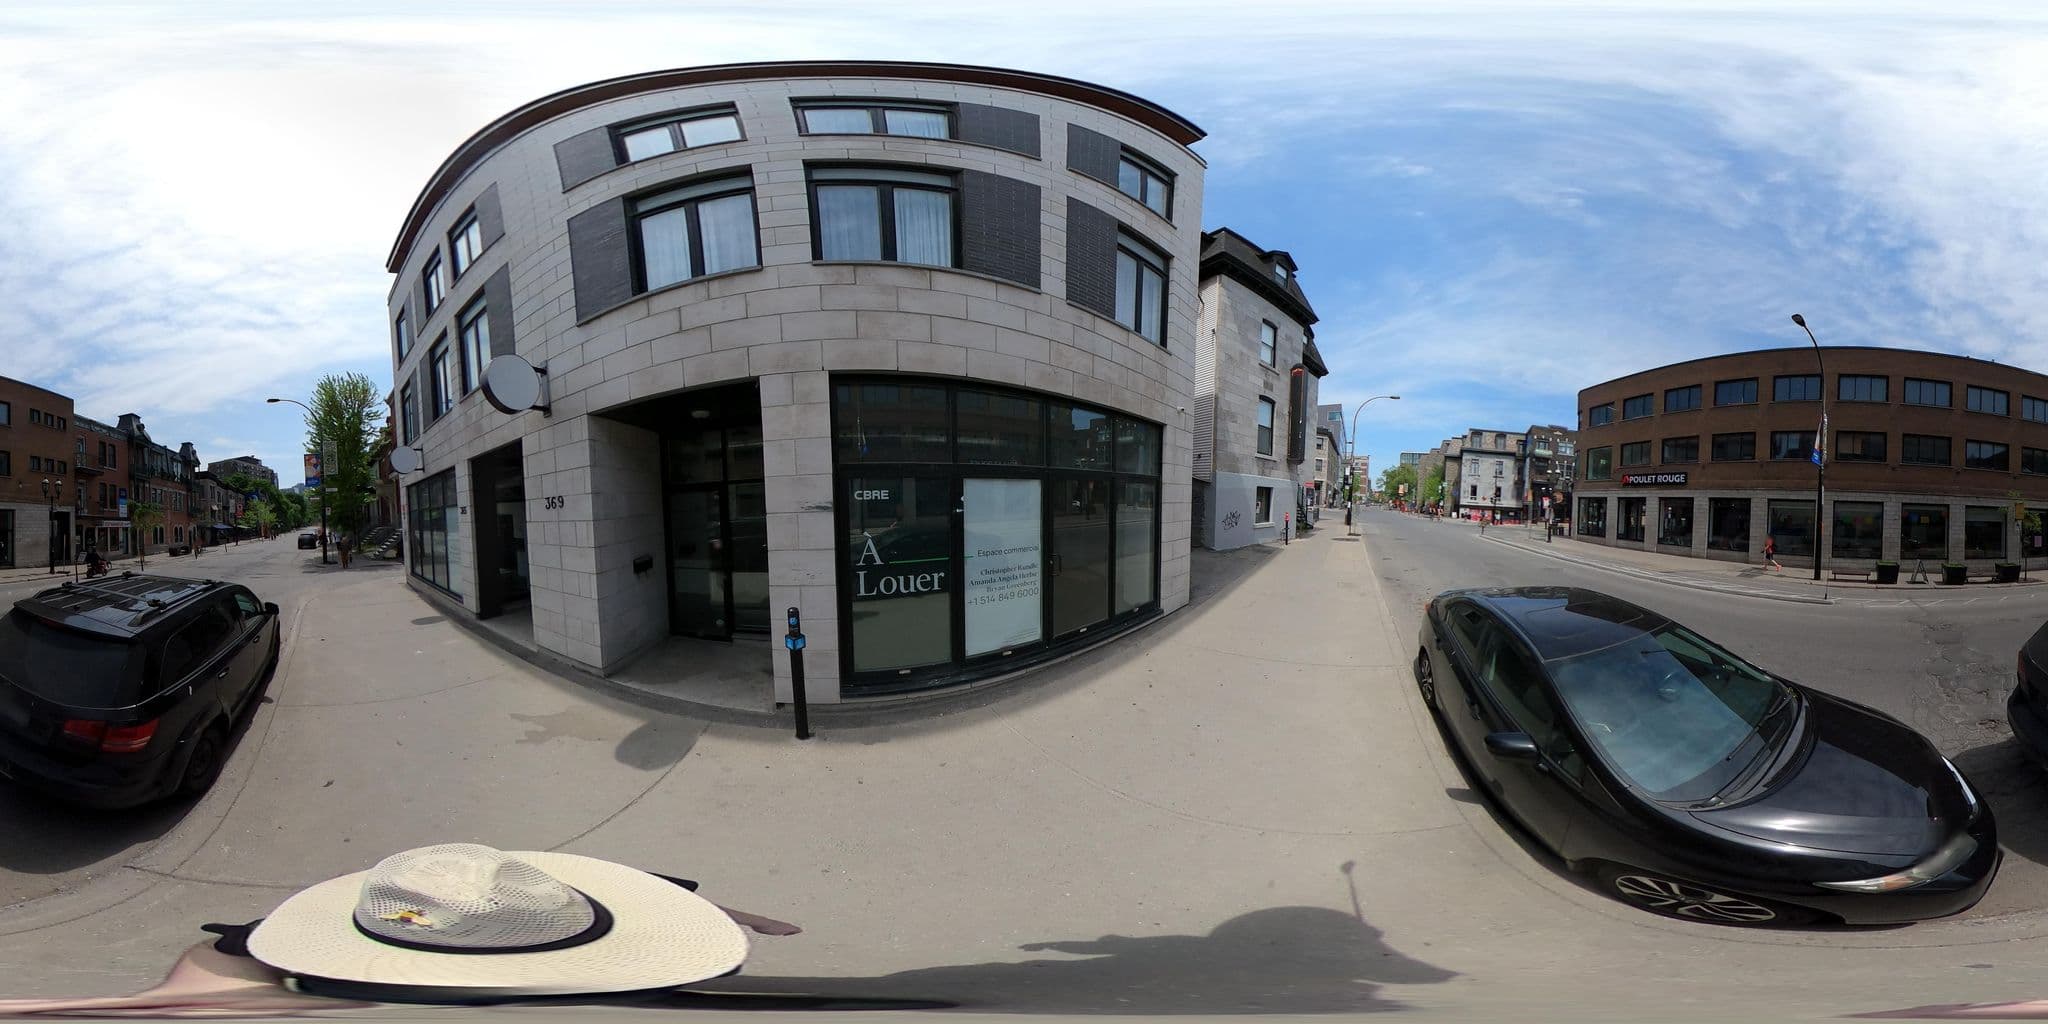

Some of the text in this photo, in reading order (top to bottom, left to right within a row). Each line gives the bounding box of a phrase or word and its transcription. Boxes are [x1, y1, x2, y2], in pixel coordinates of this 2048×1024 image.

[1629, 474, 1686, 484] POULET ROUGE
[544, 495, 564, 509] 369
[854, 490, 889, 500] CBRE
[856, 531, 884, 566] À
[977, 545, 1040, 559] Espace commercial
[980, 565, 1017, 576] Christopher
[856, 571, 945, 596] Louer
[970, 577, 997, 586] Amanda
[980, 595, 995, 605] 514
[998, 592, 1015, 602] 849
[1017, 587, 1039, 598] 6000
